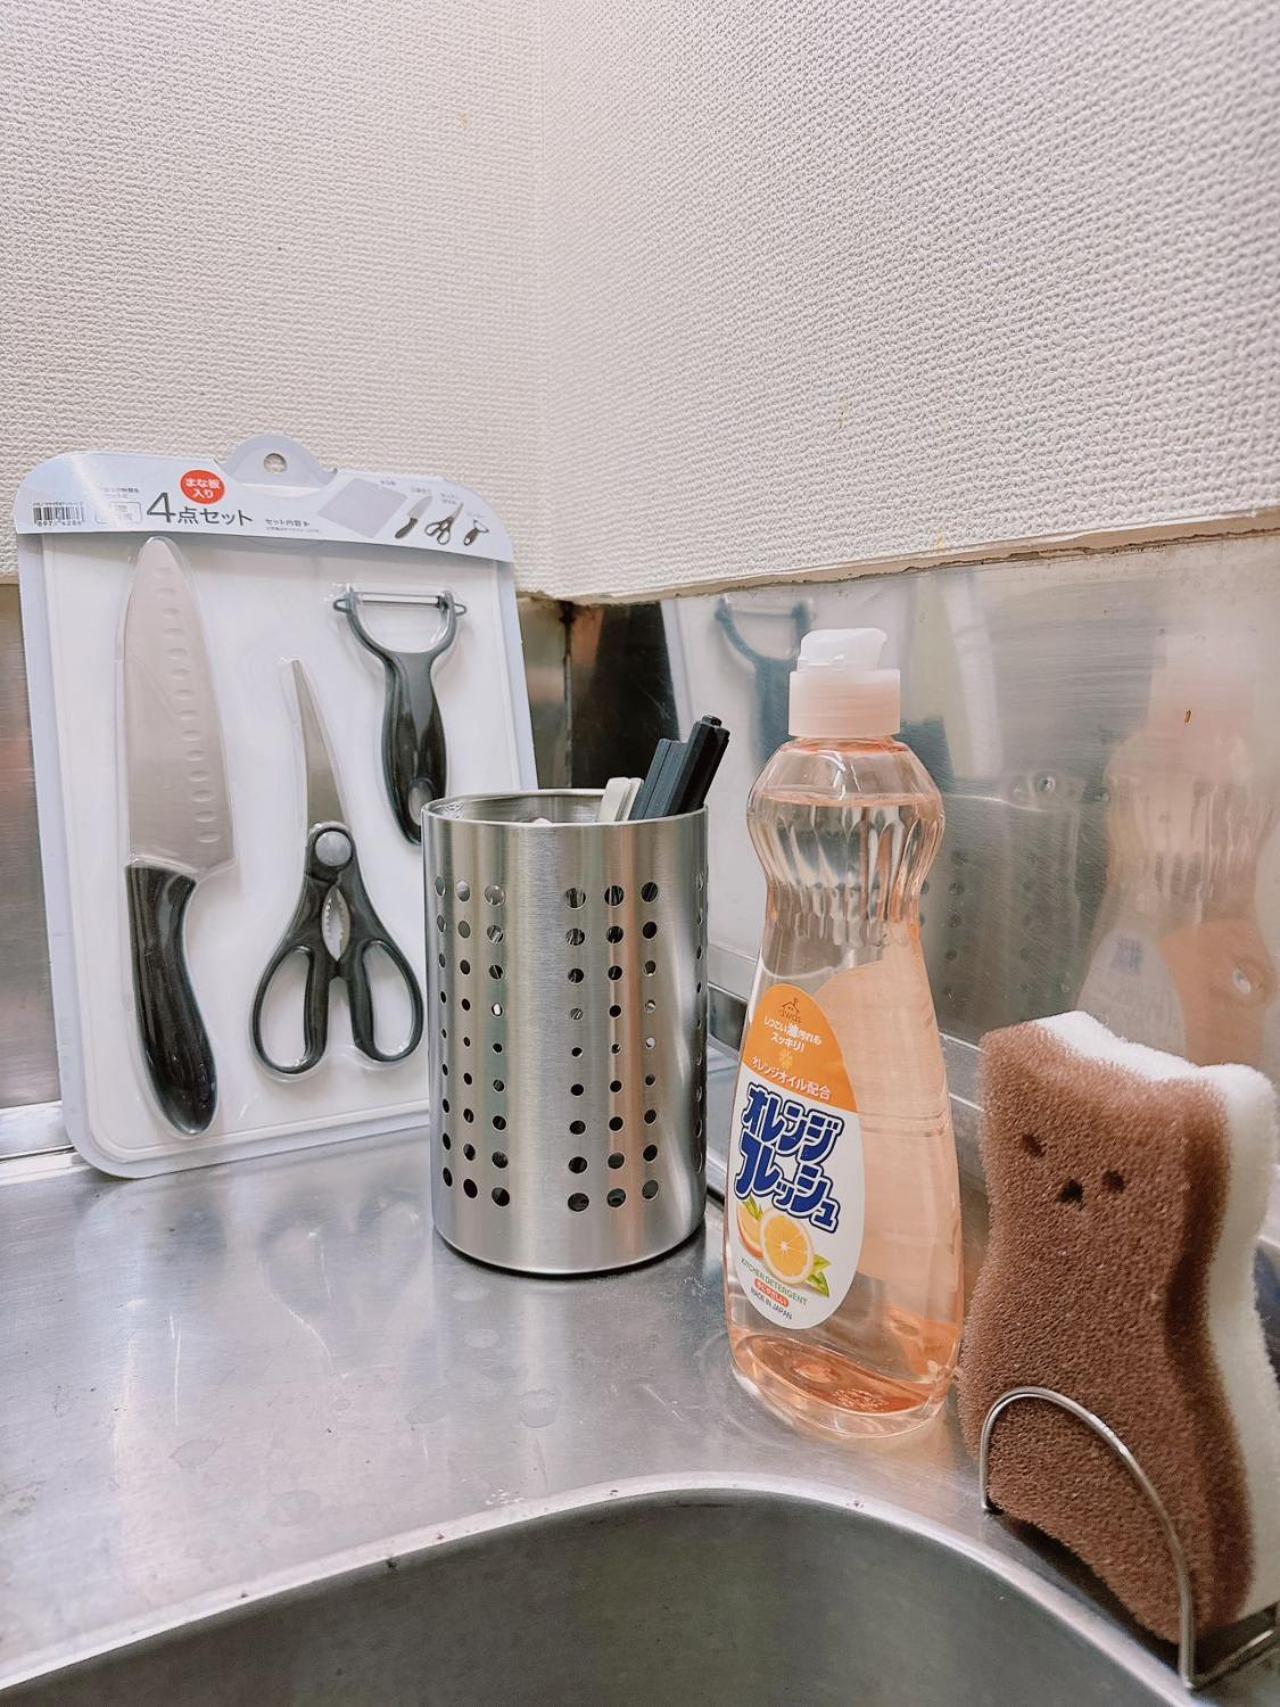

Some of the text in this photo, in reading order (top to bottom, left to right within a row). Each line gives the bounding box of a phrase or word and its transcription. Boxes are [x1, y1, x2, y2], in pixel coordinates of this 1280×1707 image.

[185, 477, 222, 490] まな板
[193, 488, 214, 499] 入り
[146, 491, 253, 527] 4点セット
[752, 1055, 832, 1100] オレンジオイル配合
[742, 1082, 845, 1165] オレンジ
[734, 1129, 841, 1234] フレッシュ
[765, 1275, 808, 1306] DETERGENT
[772, 1305, 793, 1321] JAPAN
